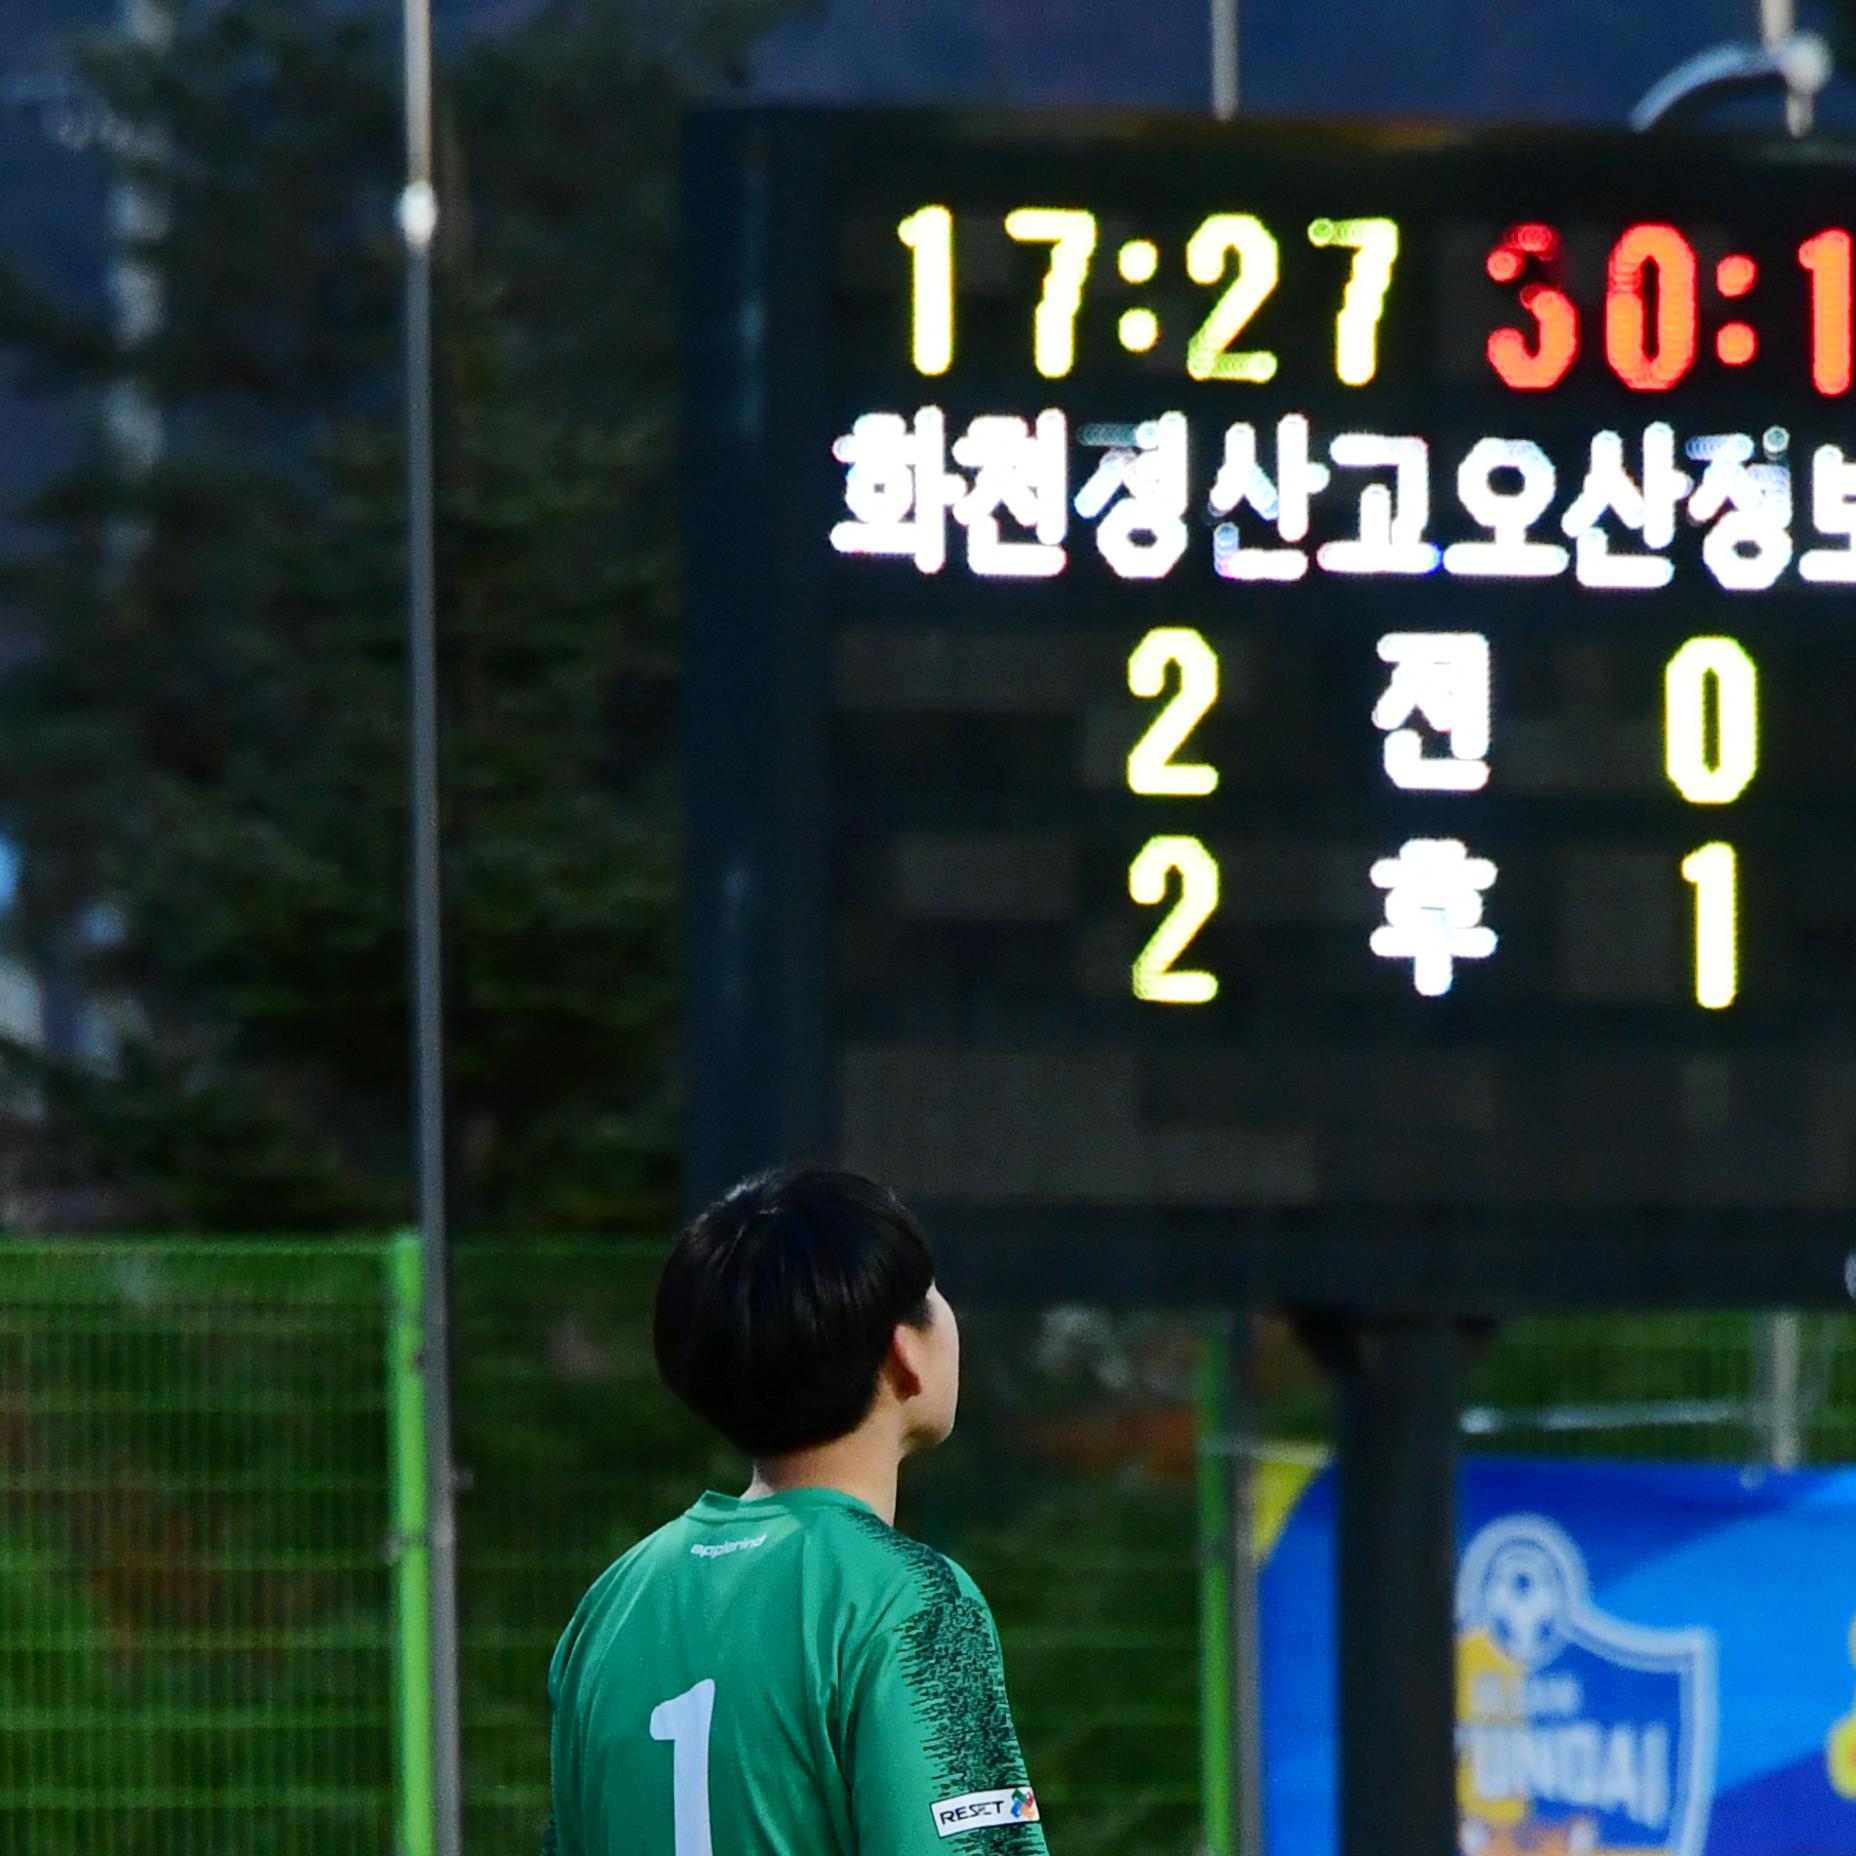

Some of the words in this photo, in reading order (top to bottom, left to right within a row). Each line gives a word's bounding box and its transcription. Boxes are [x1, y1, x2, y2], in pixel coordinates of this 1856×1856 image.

[897, 205, 1399, 387] 17:27
[1126, 627, 1219, 796] 2
[1371, 632, 1491, 793] 전
[1664, 635, 1759, 805] 0
[1129, 835, 1220, 1004] 2
[1369, 838, 1498, 996] 후
[1681, 841, 1738, 1009] 1
[939, 1800, 1005, 1826] RESET
